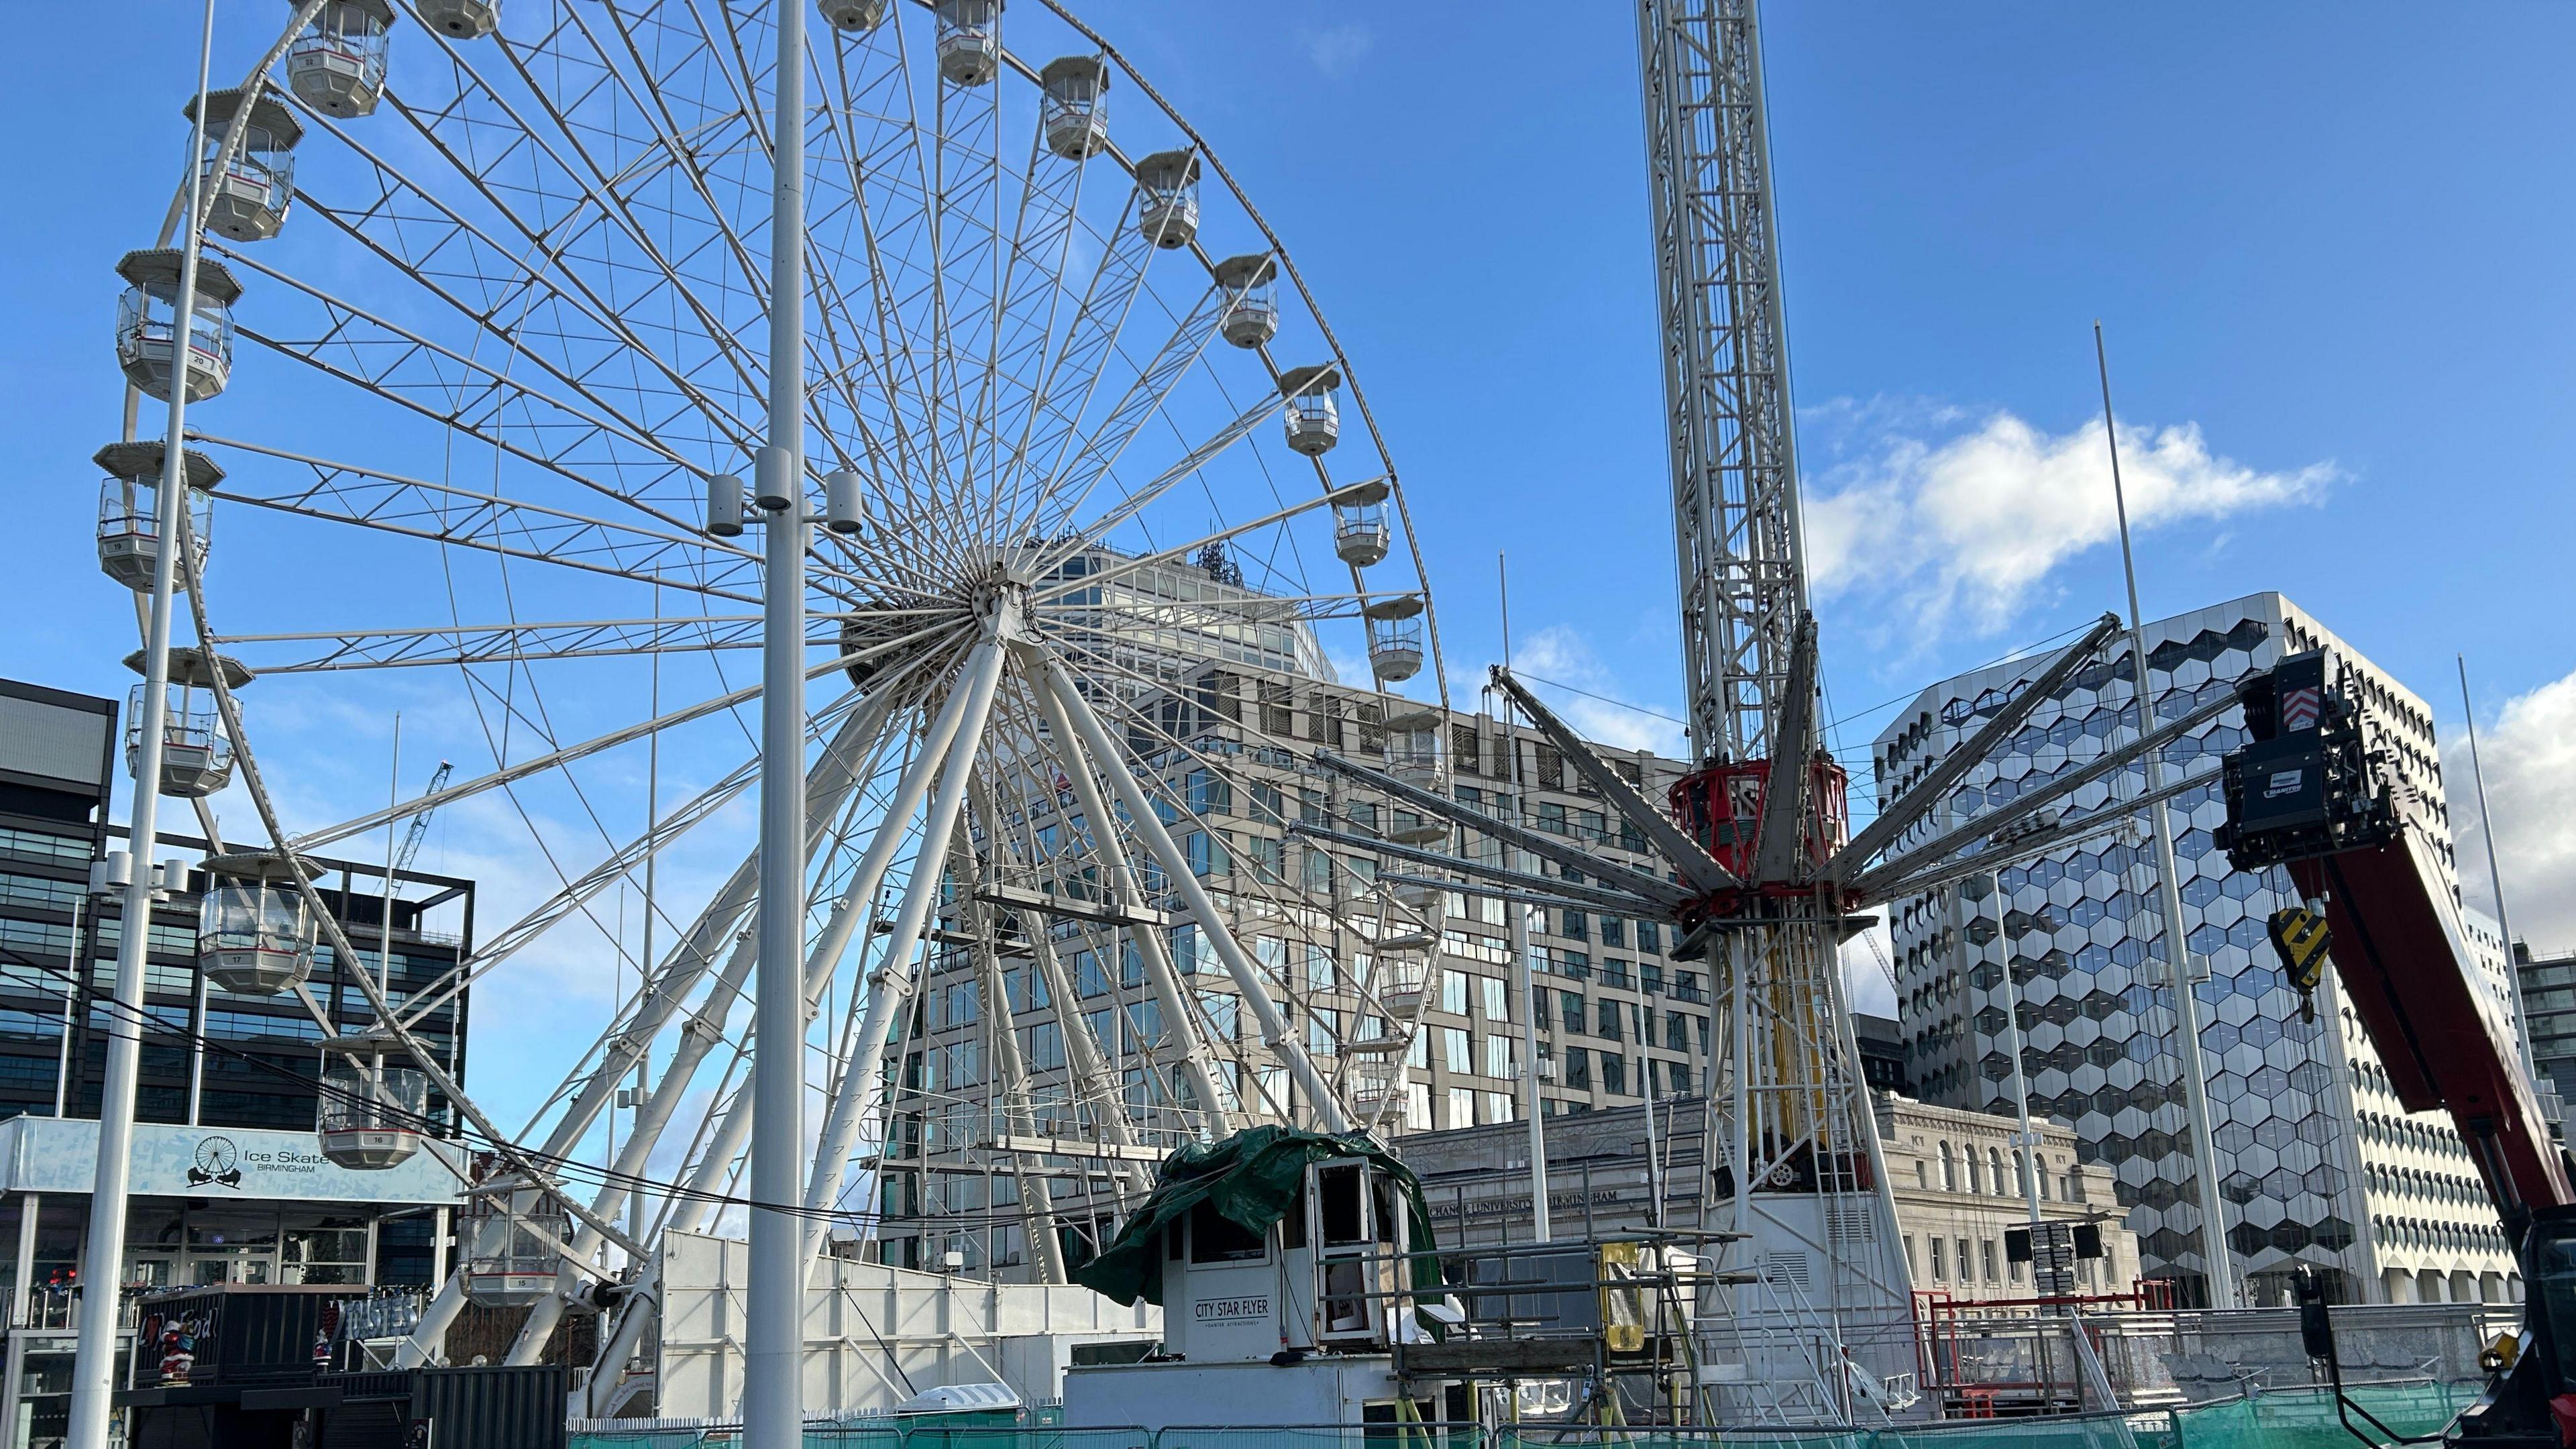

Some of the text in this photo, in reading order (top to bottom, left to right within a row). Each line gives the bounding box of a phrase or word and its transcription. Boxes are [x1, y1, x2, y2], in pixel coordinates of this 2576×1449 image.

[195, 356, 203, 364] 20
[244, 1150, 330, 1165] Ice Skate
[257, 1163, 315, 1173] BIRMINGHAM
[1548, 1191, 1617, 1205] BIRMINHAM
[1195, 1299, 1268, 1318] CITY STAR FLYER
[345, 1295, 418, 1340] TOASTIES
